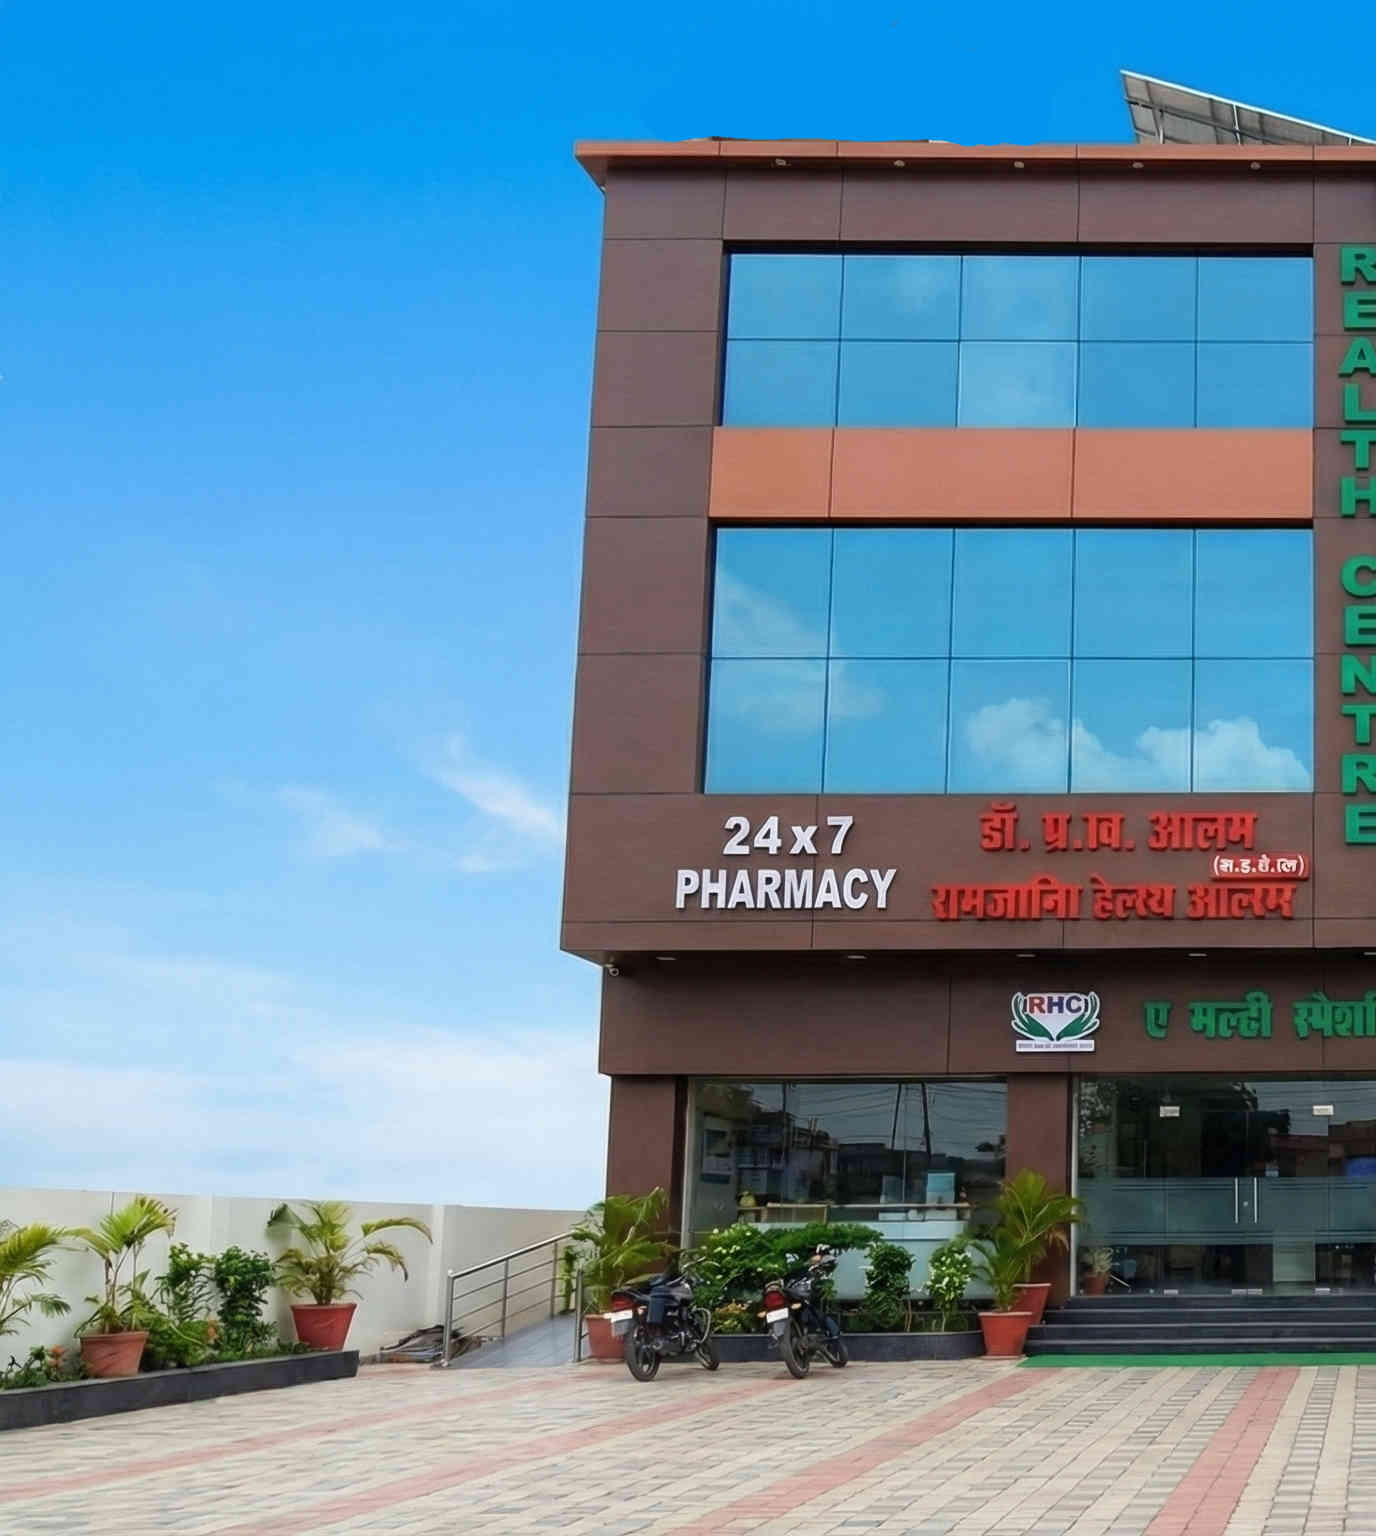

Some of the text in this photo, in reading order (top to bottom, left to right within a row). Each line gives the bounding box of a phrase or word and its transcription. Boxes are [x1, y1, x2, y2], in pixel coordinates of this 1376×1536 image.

[723, 815, 854, 856] 24 x 7
[675, 868, 897, 909] PHARMACY
[1028, 994, 1083, 1014] RHC
